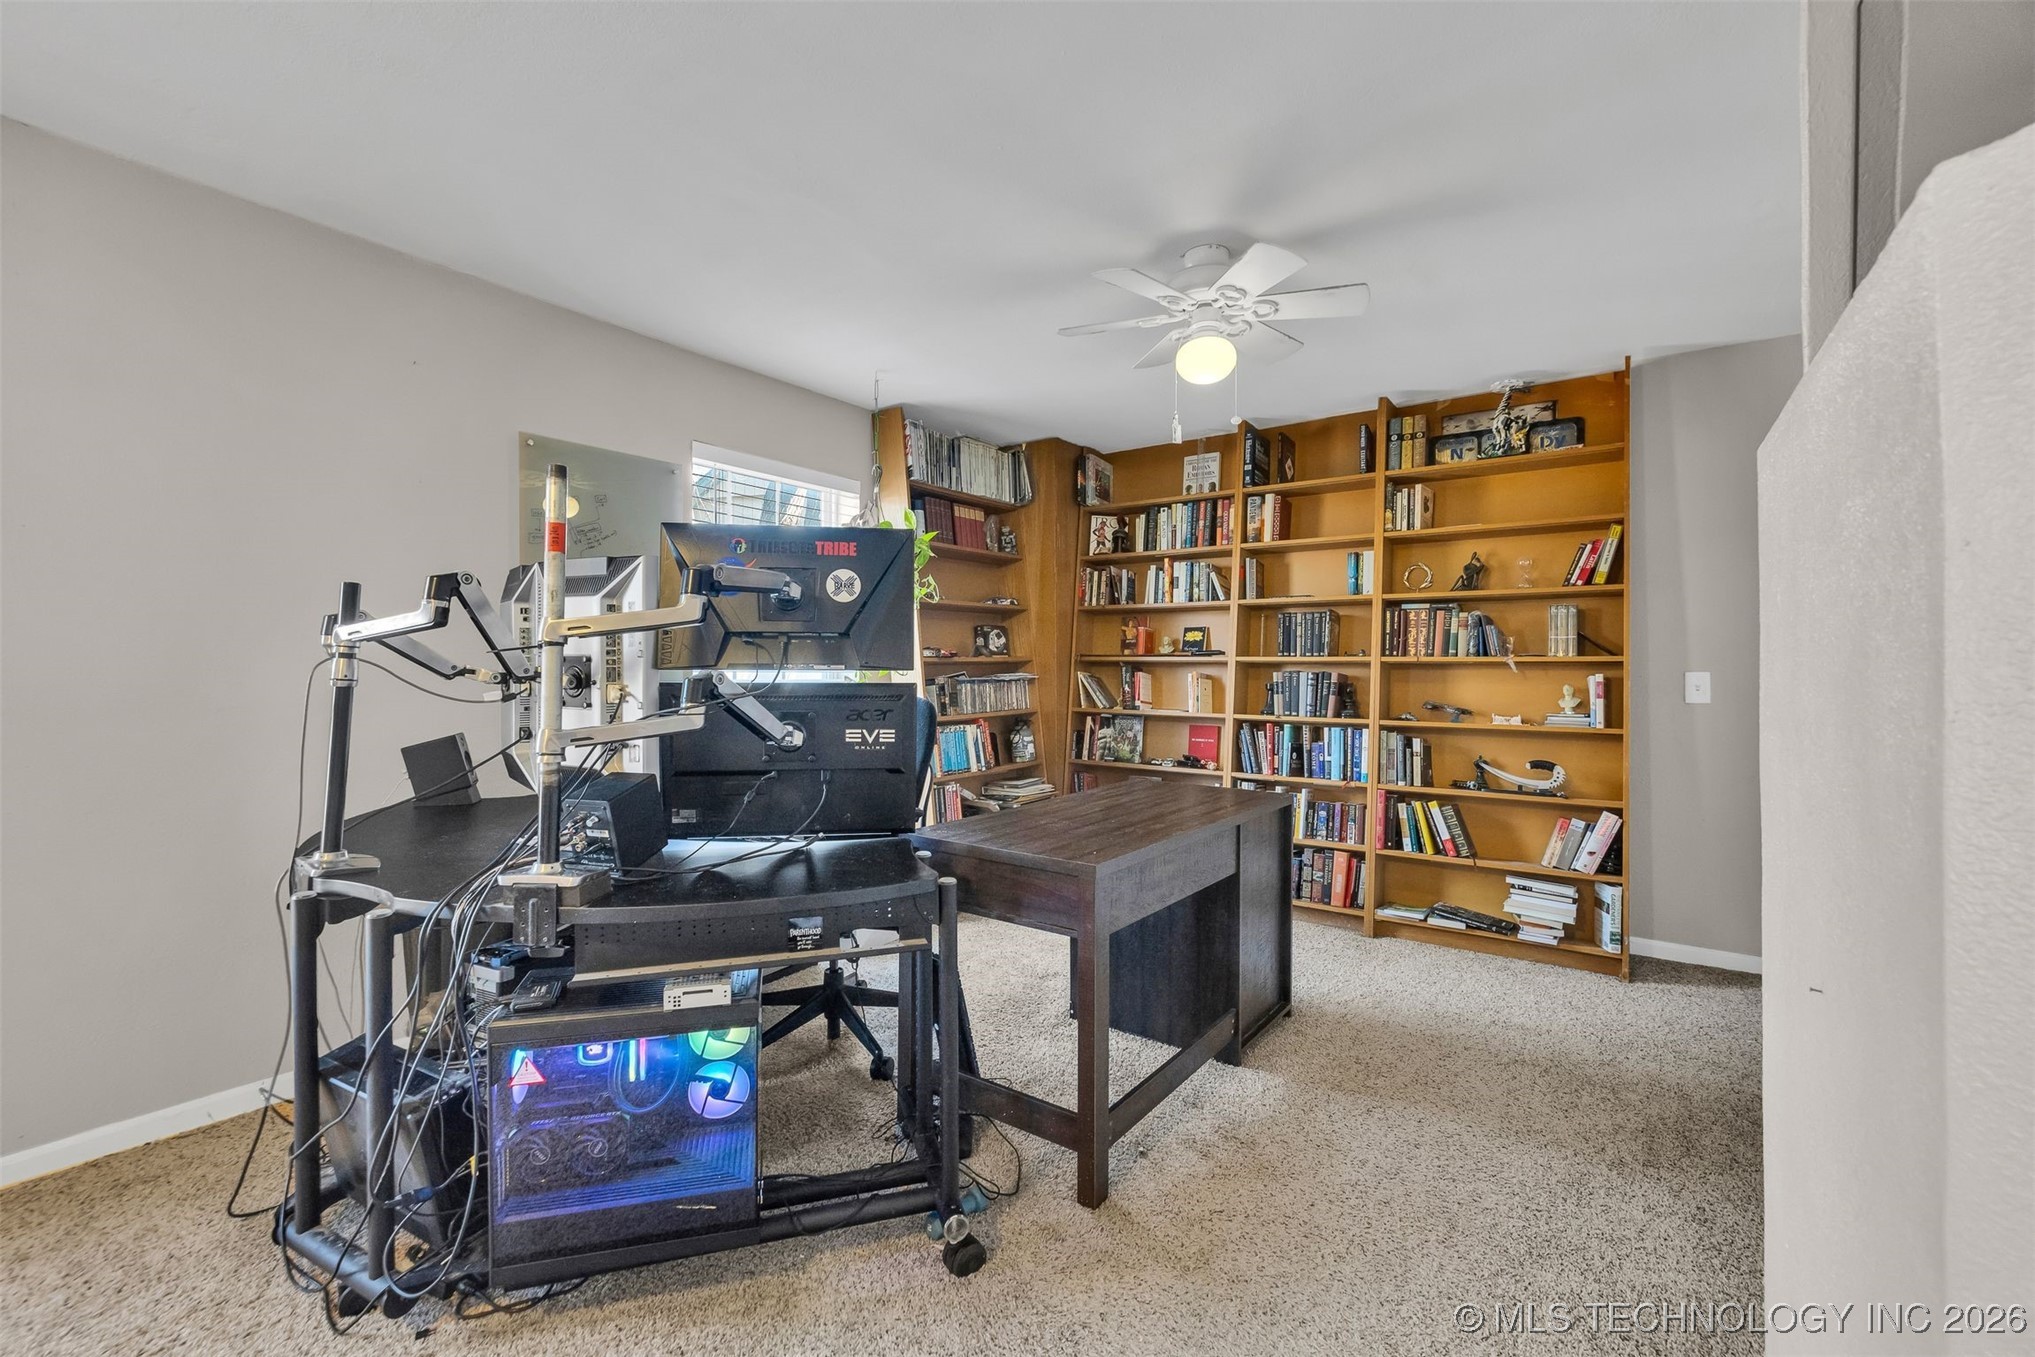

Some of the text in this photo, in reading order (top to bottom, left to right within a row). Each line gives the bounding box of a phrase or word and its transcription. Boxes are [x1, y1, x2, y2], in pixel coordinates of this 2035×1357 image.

[815, 541, 857, 556] TRIBE
[846, 708, 894, 722] acer
[845, 729, 896, 742] EVE
